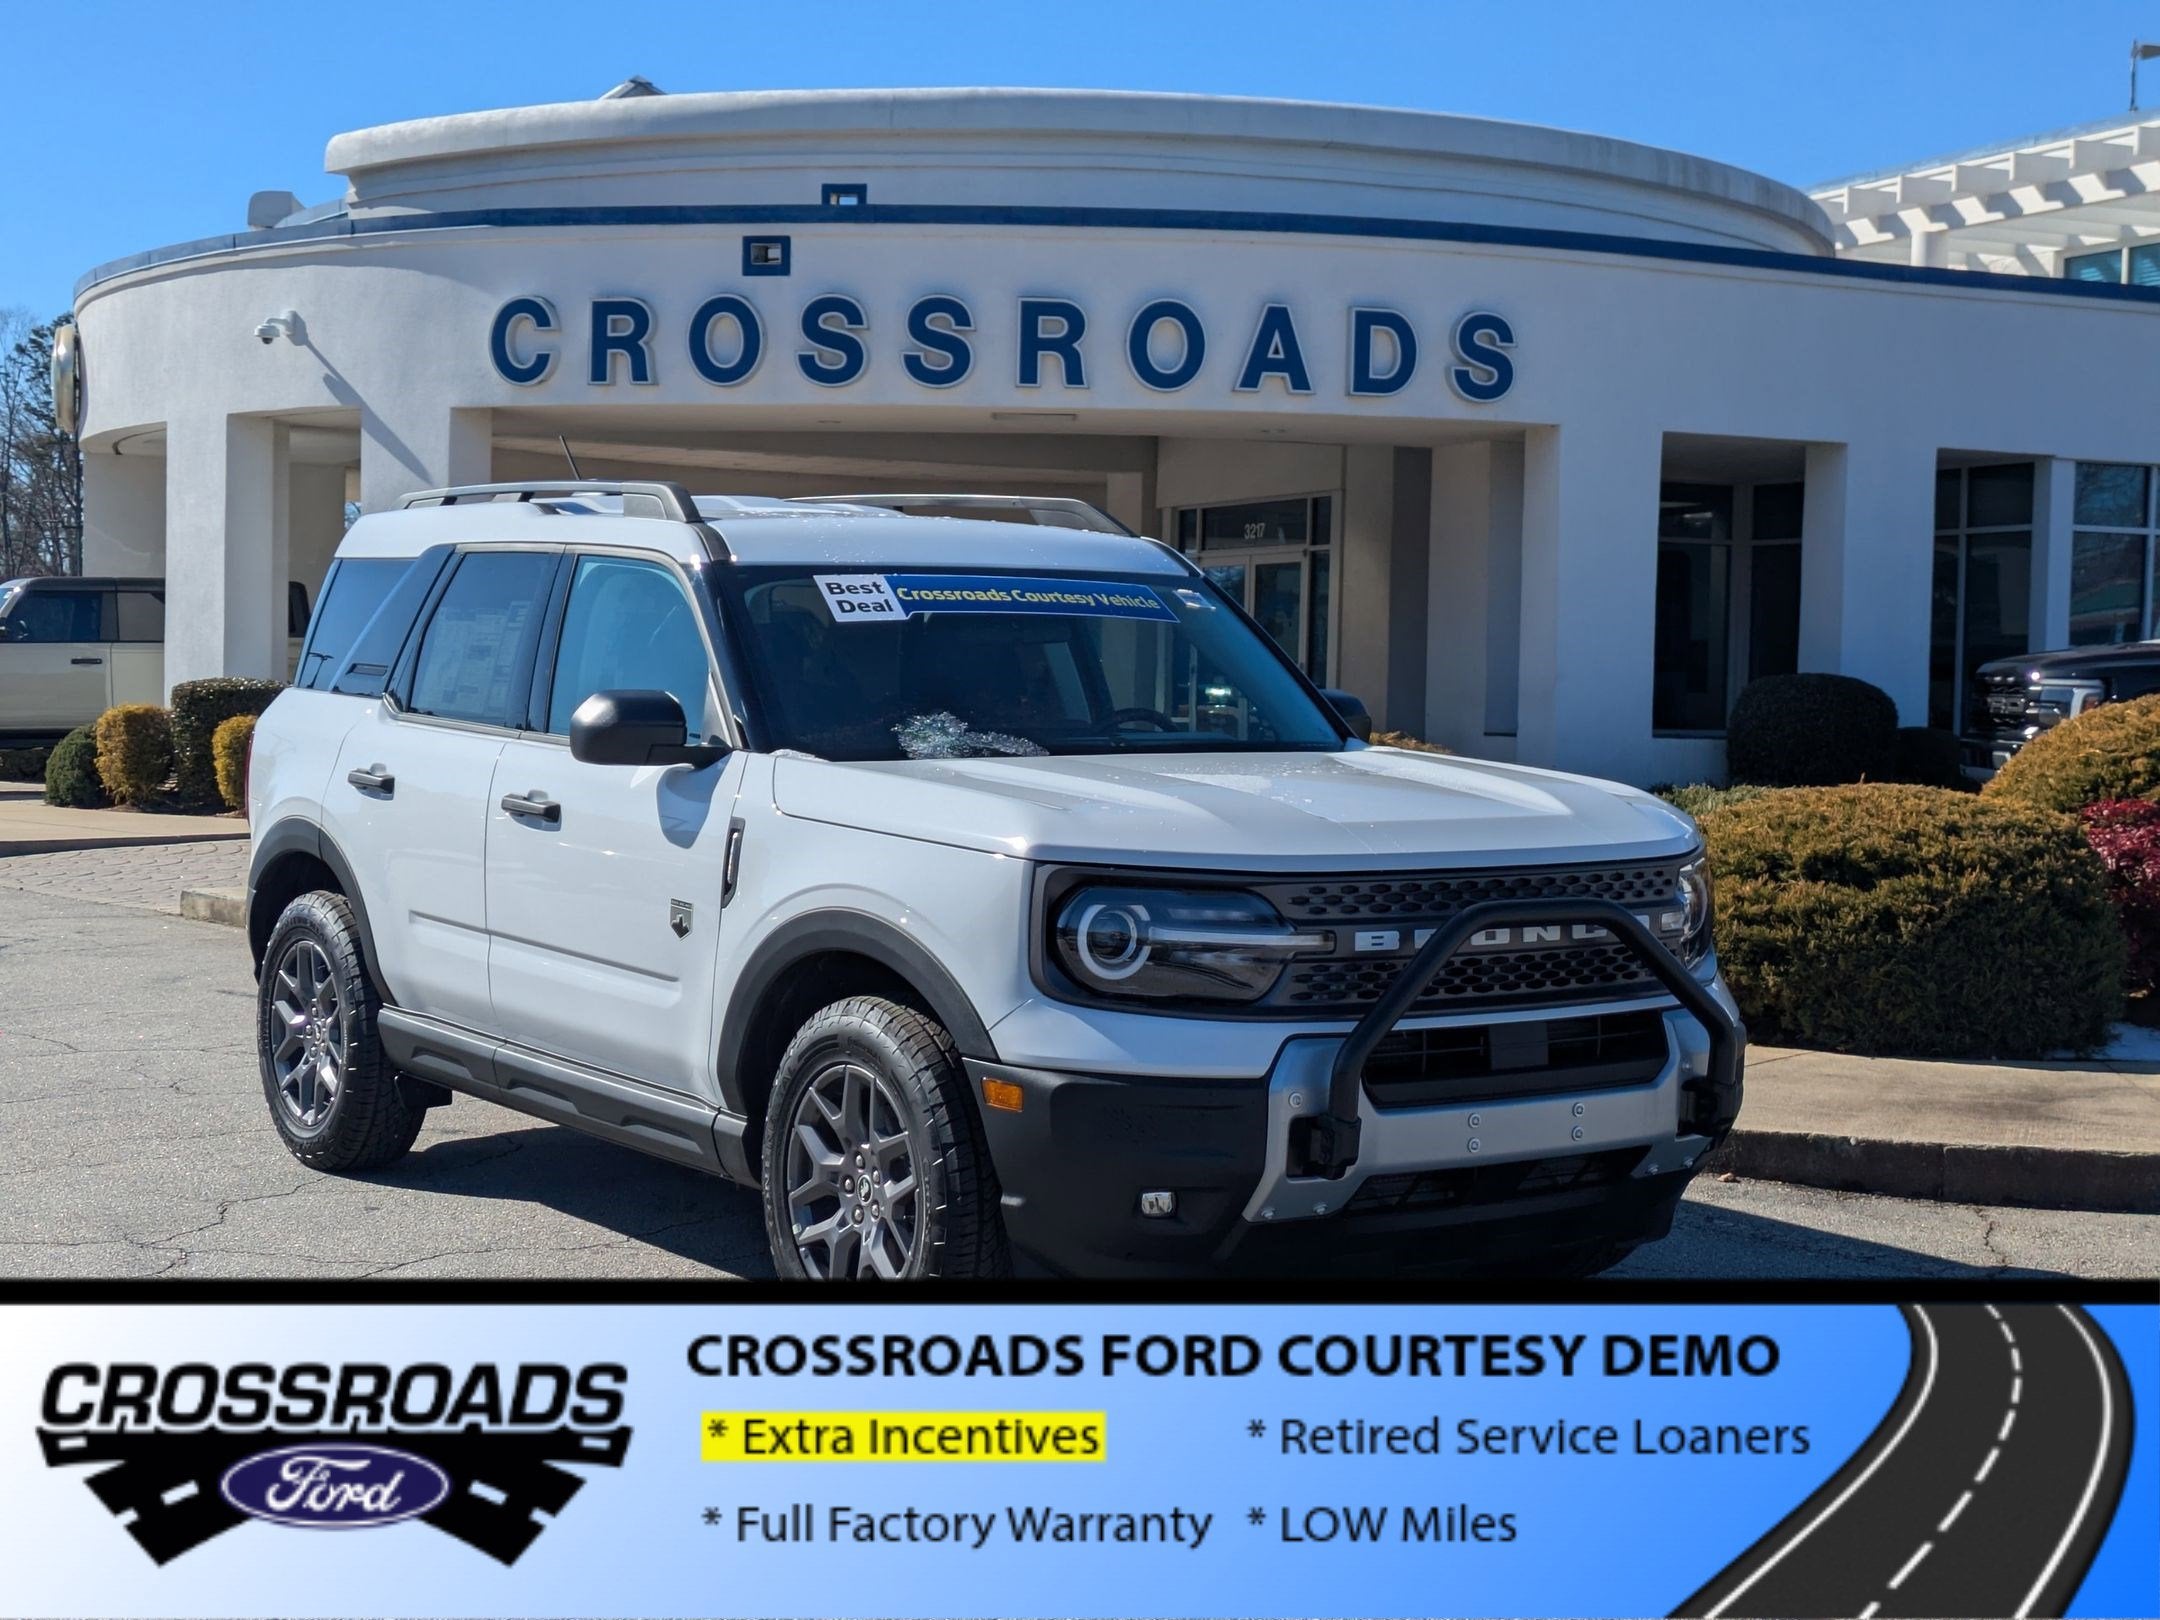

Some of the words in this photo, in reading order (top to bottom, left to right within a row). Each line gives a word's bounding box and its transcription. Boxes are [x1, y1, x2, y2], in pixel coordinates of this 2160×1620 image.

[490, 293, 1517, 402] CROSSROADS
[1244, 523, 1266, 540] 3217
[825, 581, 885, 596] Best
[837, 598, 895, 613] Deal
[896, 586, 1011, 603] Crossroads
[1011, 589, 1097, 607] Courtesy
[1096, 592, 1162, 609] Vehicle
